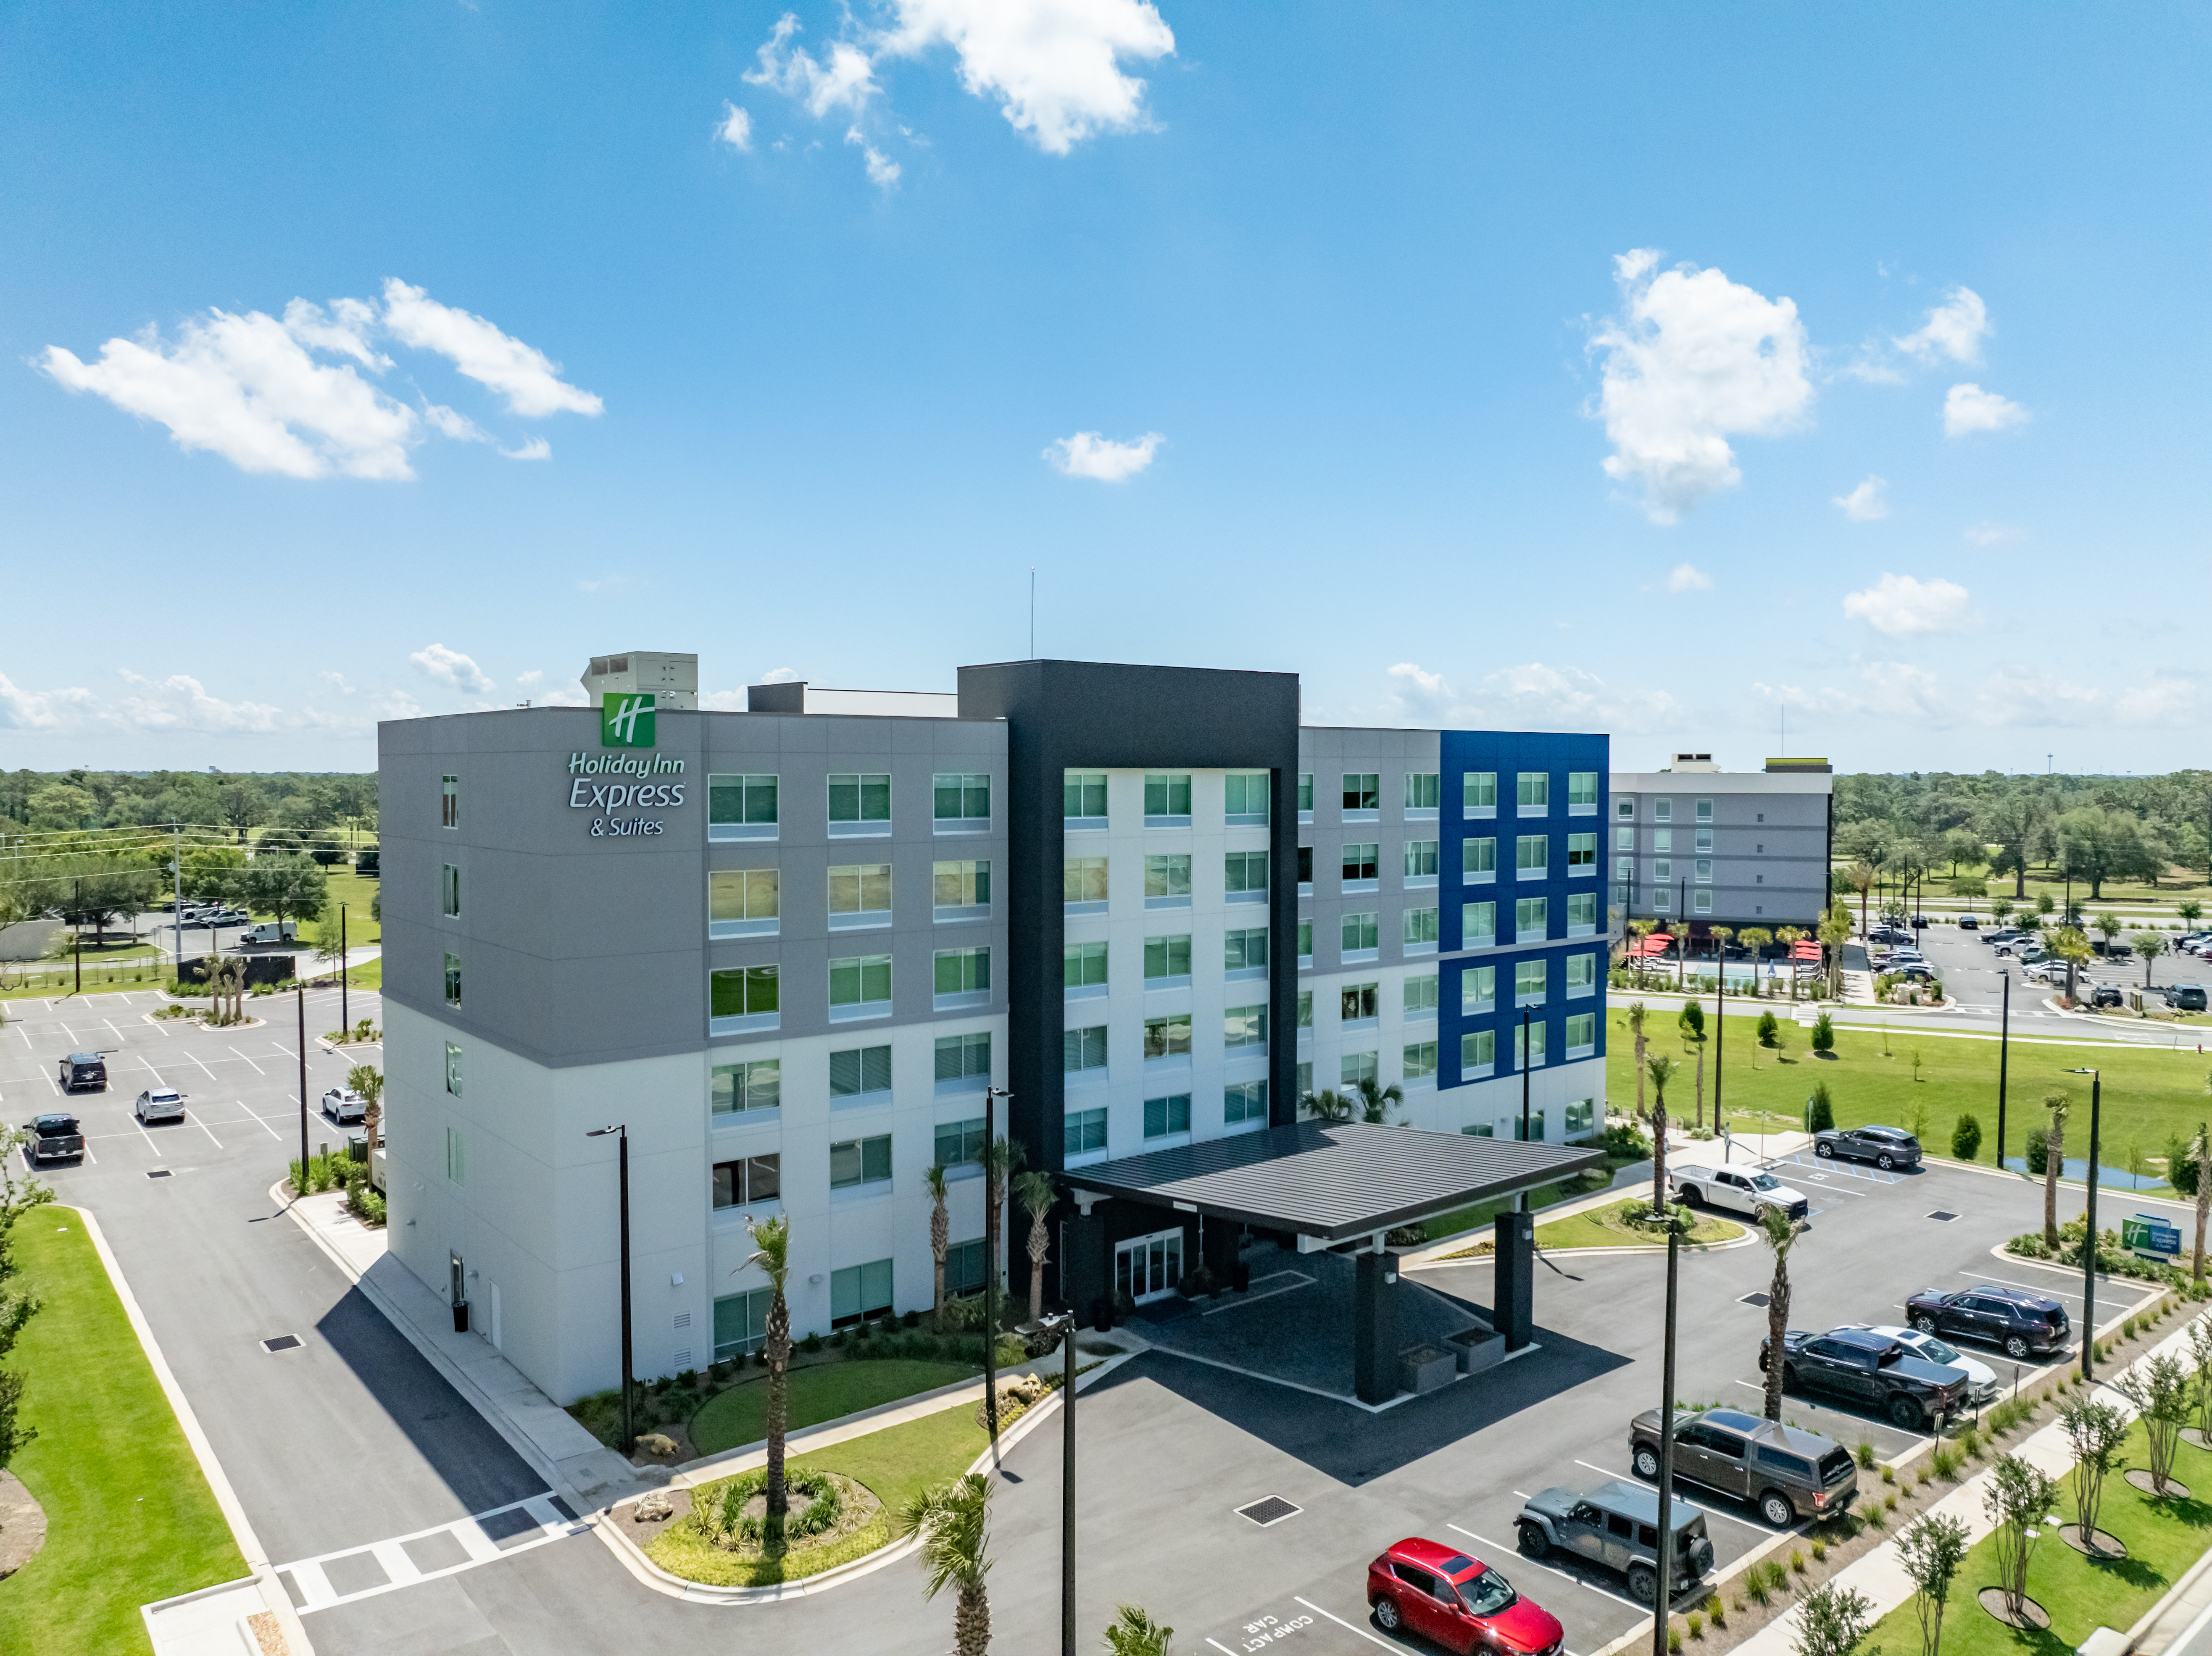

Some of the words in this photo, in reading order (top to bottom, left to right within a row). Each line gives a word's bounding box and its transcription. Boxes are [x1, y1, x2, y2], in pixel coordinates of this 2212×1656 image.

[569, 752, 650, 779] Holiday
[653, 753, 685, 774] Inn
[569, 778, 685, 815] Express
[590, 818, 604, 836] &
[608, 817, 664, 836] Suites
[1243, 1615, 1278, 1633] CAR
